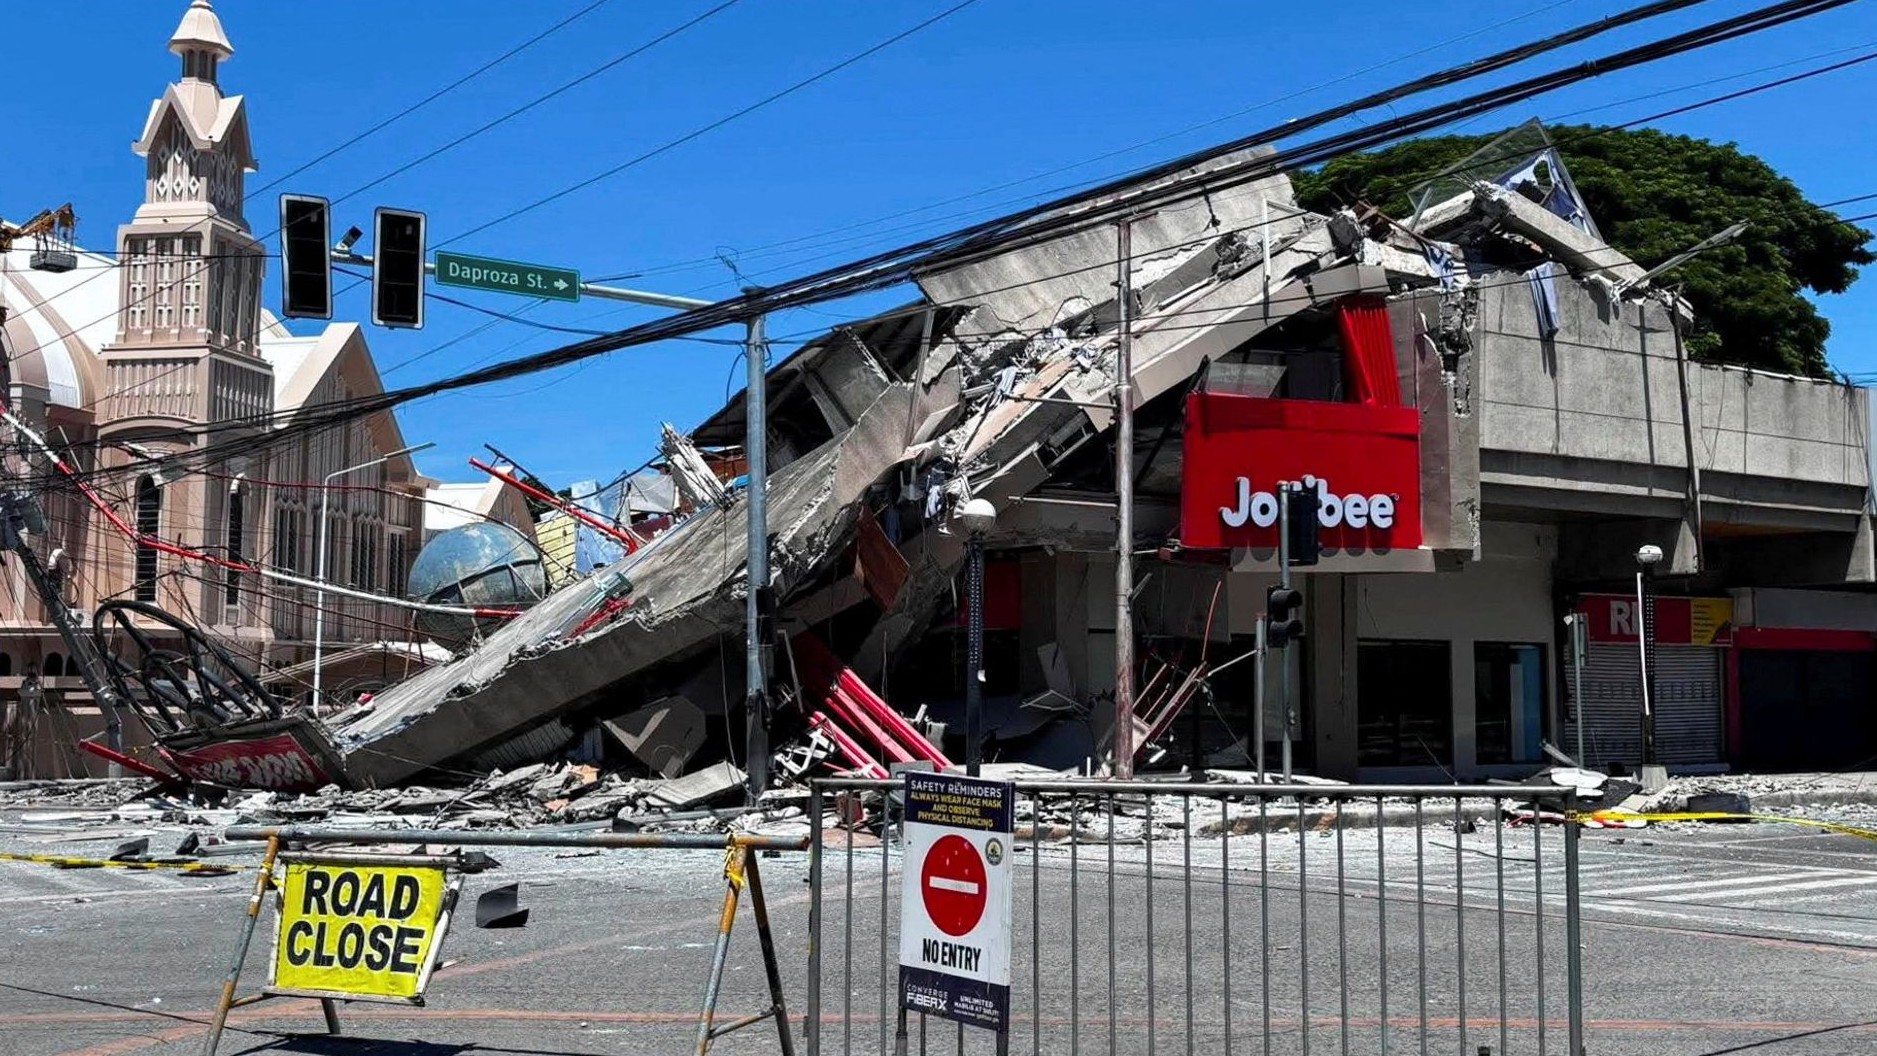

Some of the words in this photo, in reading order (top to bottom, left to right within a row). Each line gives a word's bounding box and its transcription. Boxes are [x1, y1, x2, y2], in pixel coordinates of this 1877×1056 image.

[449, 262, 519, 285] Daproza
[527, 273, 547, 289] St.
[911, 780, 946, 792] SAFETY
[948, 783, 1002, 798] REMINDERS
[910, 792, 940, 801] ALWAYS
[940, 795, 961, 804] WEAR
[962, 797, 981, 807] FACE
[982, 799, 1002, 808] MASK
[932, 804, 948, 812] AND
[948, 805, 981, 817] OBSERVE
[918, 811, 951, 821] PHYSICAL
[951, 815, 993, 828] DISTANCING
[302, 870, 420, 920] ROAD
[286, 920, 425, 973] CLOSE
[923, 938, 939, 963] NO
[941, 942, 981, 972] ENTRY
[906, 983, 948, 1000] CONVERGE
[960, 995, 994, 1009] UNLIMITED
